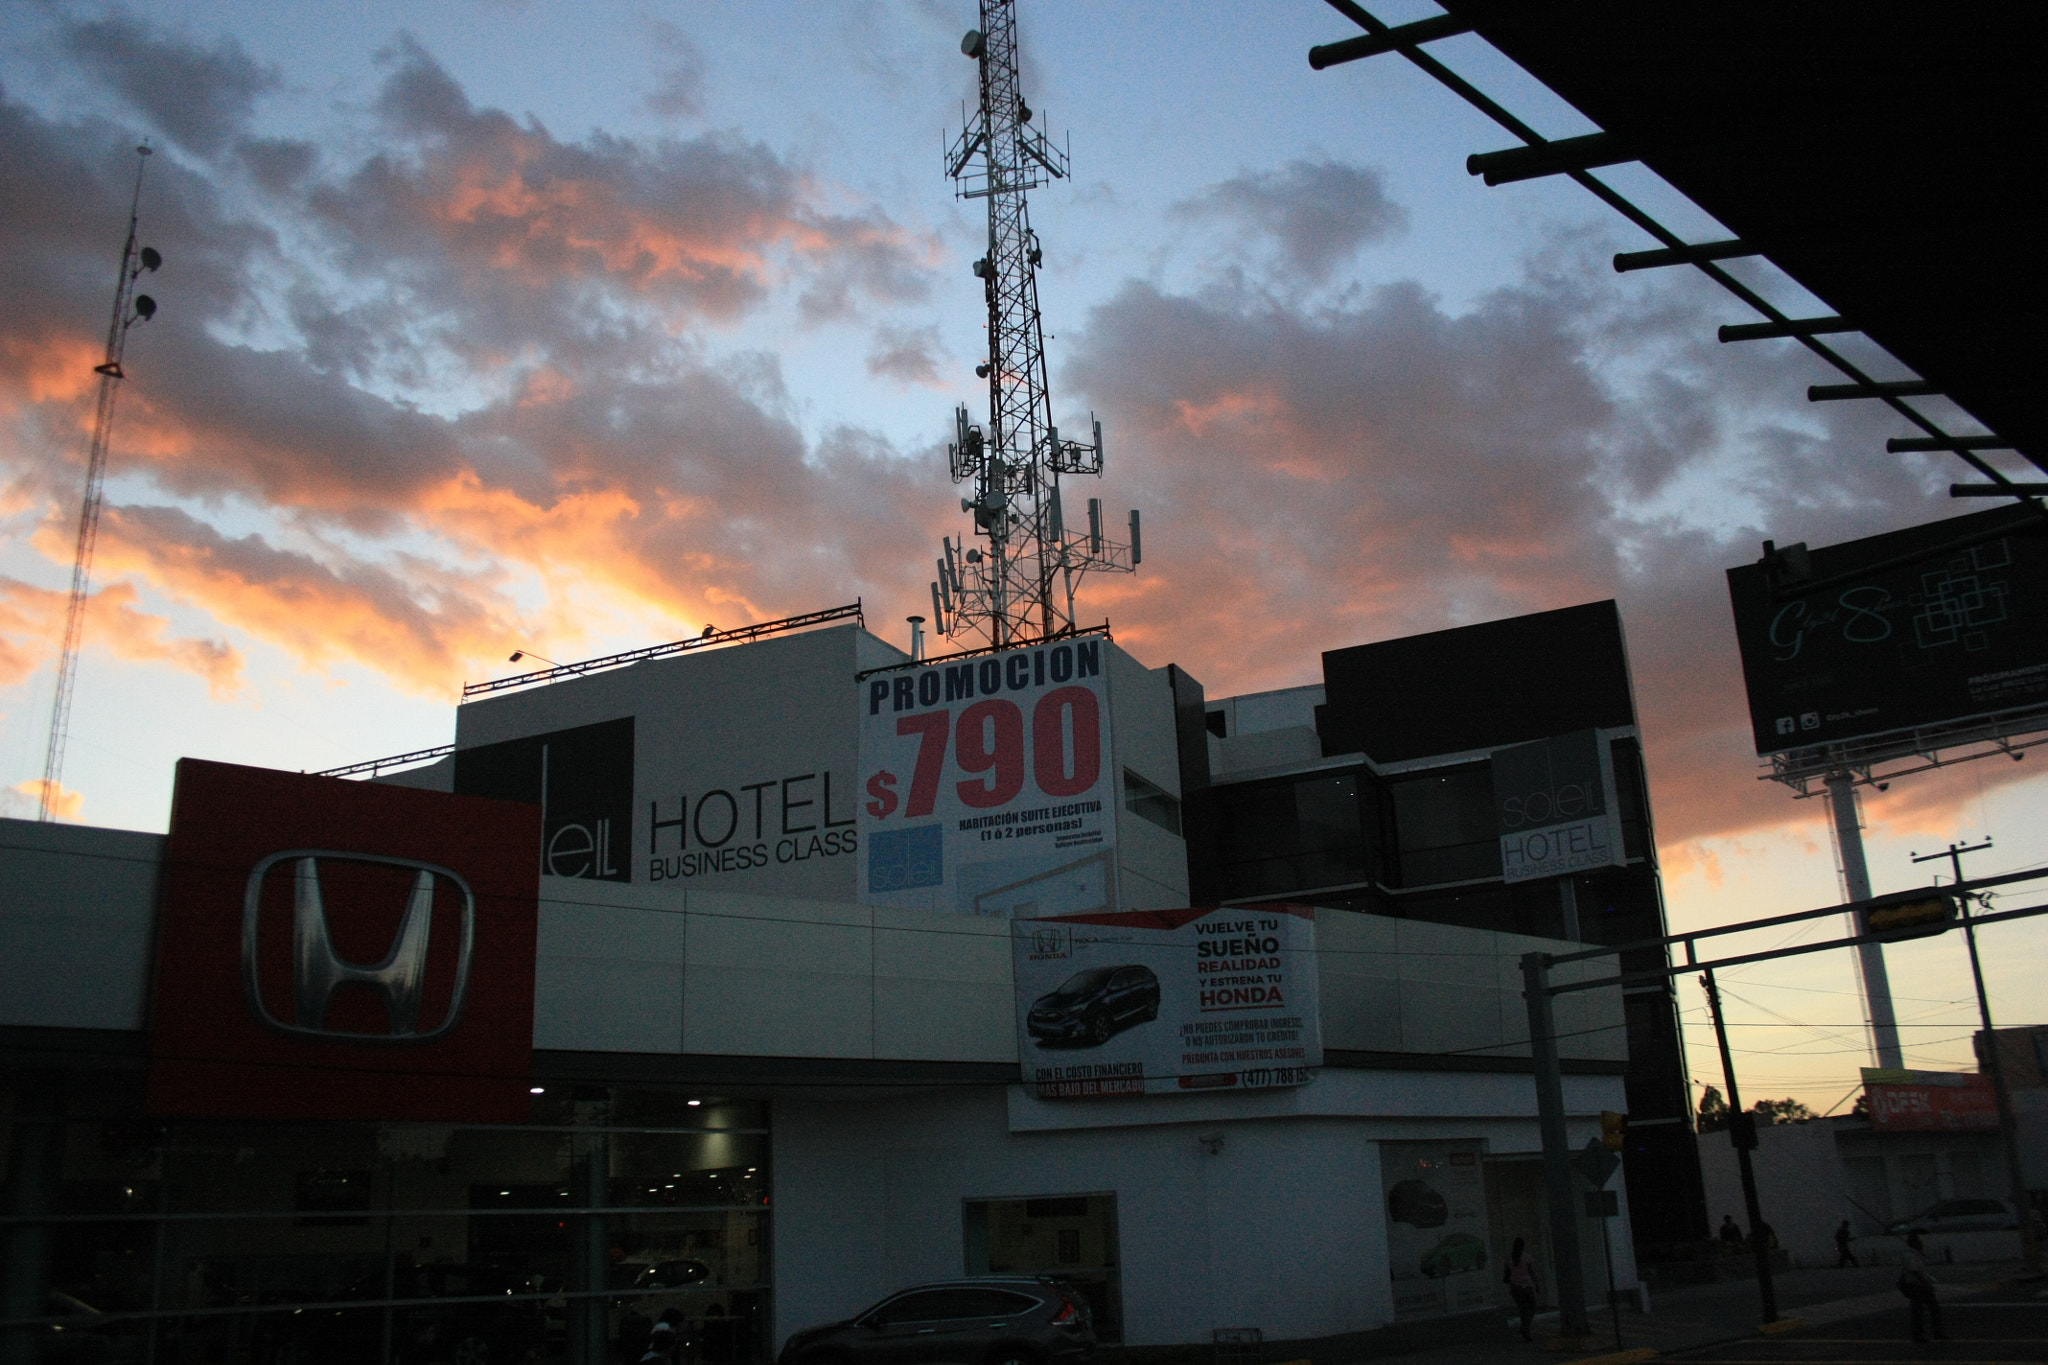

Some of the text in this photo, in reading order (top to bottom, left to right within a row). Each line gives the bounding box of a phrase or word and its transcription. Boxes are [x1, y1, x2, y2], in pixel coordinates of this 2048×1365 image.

[869, 639, 1100, 716] PROMOCION
[866, 685, 1101, 820] $790
[650, 771, 857, 855] HOTEL
[959, 800, 1103, 831] HABITACIÓN SUITE EJECUTIVA
[1005, 827, 1014, 839] 2
[1015, 818, 1084, 839] personas)
[649, 828, 858, 882] BUSINESS CLASS
[1503, 823, 1607, 867] HOTEL
[1506, 849, 1609, 879] BUSINESS CLASS
[1195, 918, 1279, 935] VUELVE TU
[1196, 932, 1280, 958] SUEÑO
[1028, 952, 1067, 961] HONDA
[1197, 957, 1282, 974] REALIDAD
[1199, 974, 1283, 988] Y ESTRENA TU
[1199, 985, 1284, 1007] HONDA
[1195, 1021, 1223, 1034] PUEDES
[1224, 1018, 1269, 1032] COMPROBAR
[1185, 1036, 1191, 1047] O
[1192, 1035, 1203, 1047] NO
[1204, 1032, 1255, 1046] AUTORIZARON
[1256, 1031, 1265, 1043] TU
[1182, 1052, 1219, 1065] PREGUNTA
[1220, 1050, 1235, 1062] CON
[1236, 1048, 1273, 1061] NUESTROS
[1035, 1062, 1143, 1081] CON EL COSTO FINANCIERO
[1058, 1081, 1081, 1097] BAJO
[1082, 1079, 1100, 1095] DEL
[1101, 1077, 1145, 1094] MERCADO
